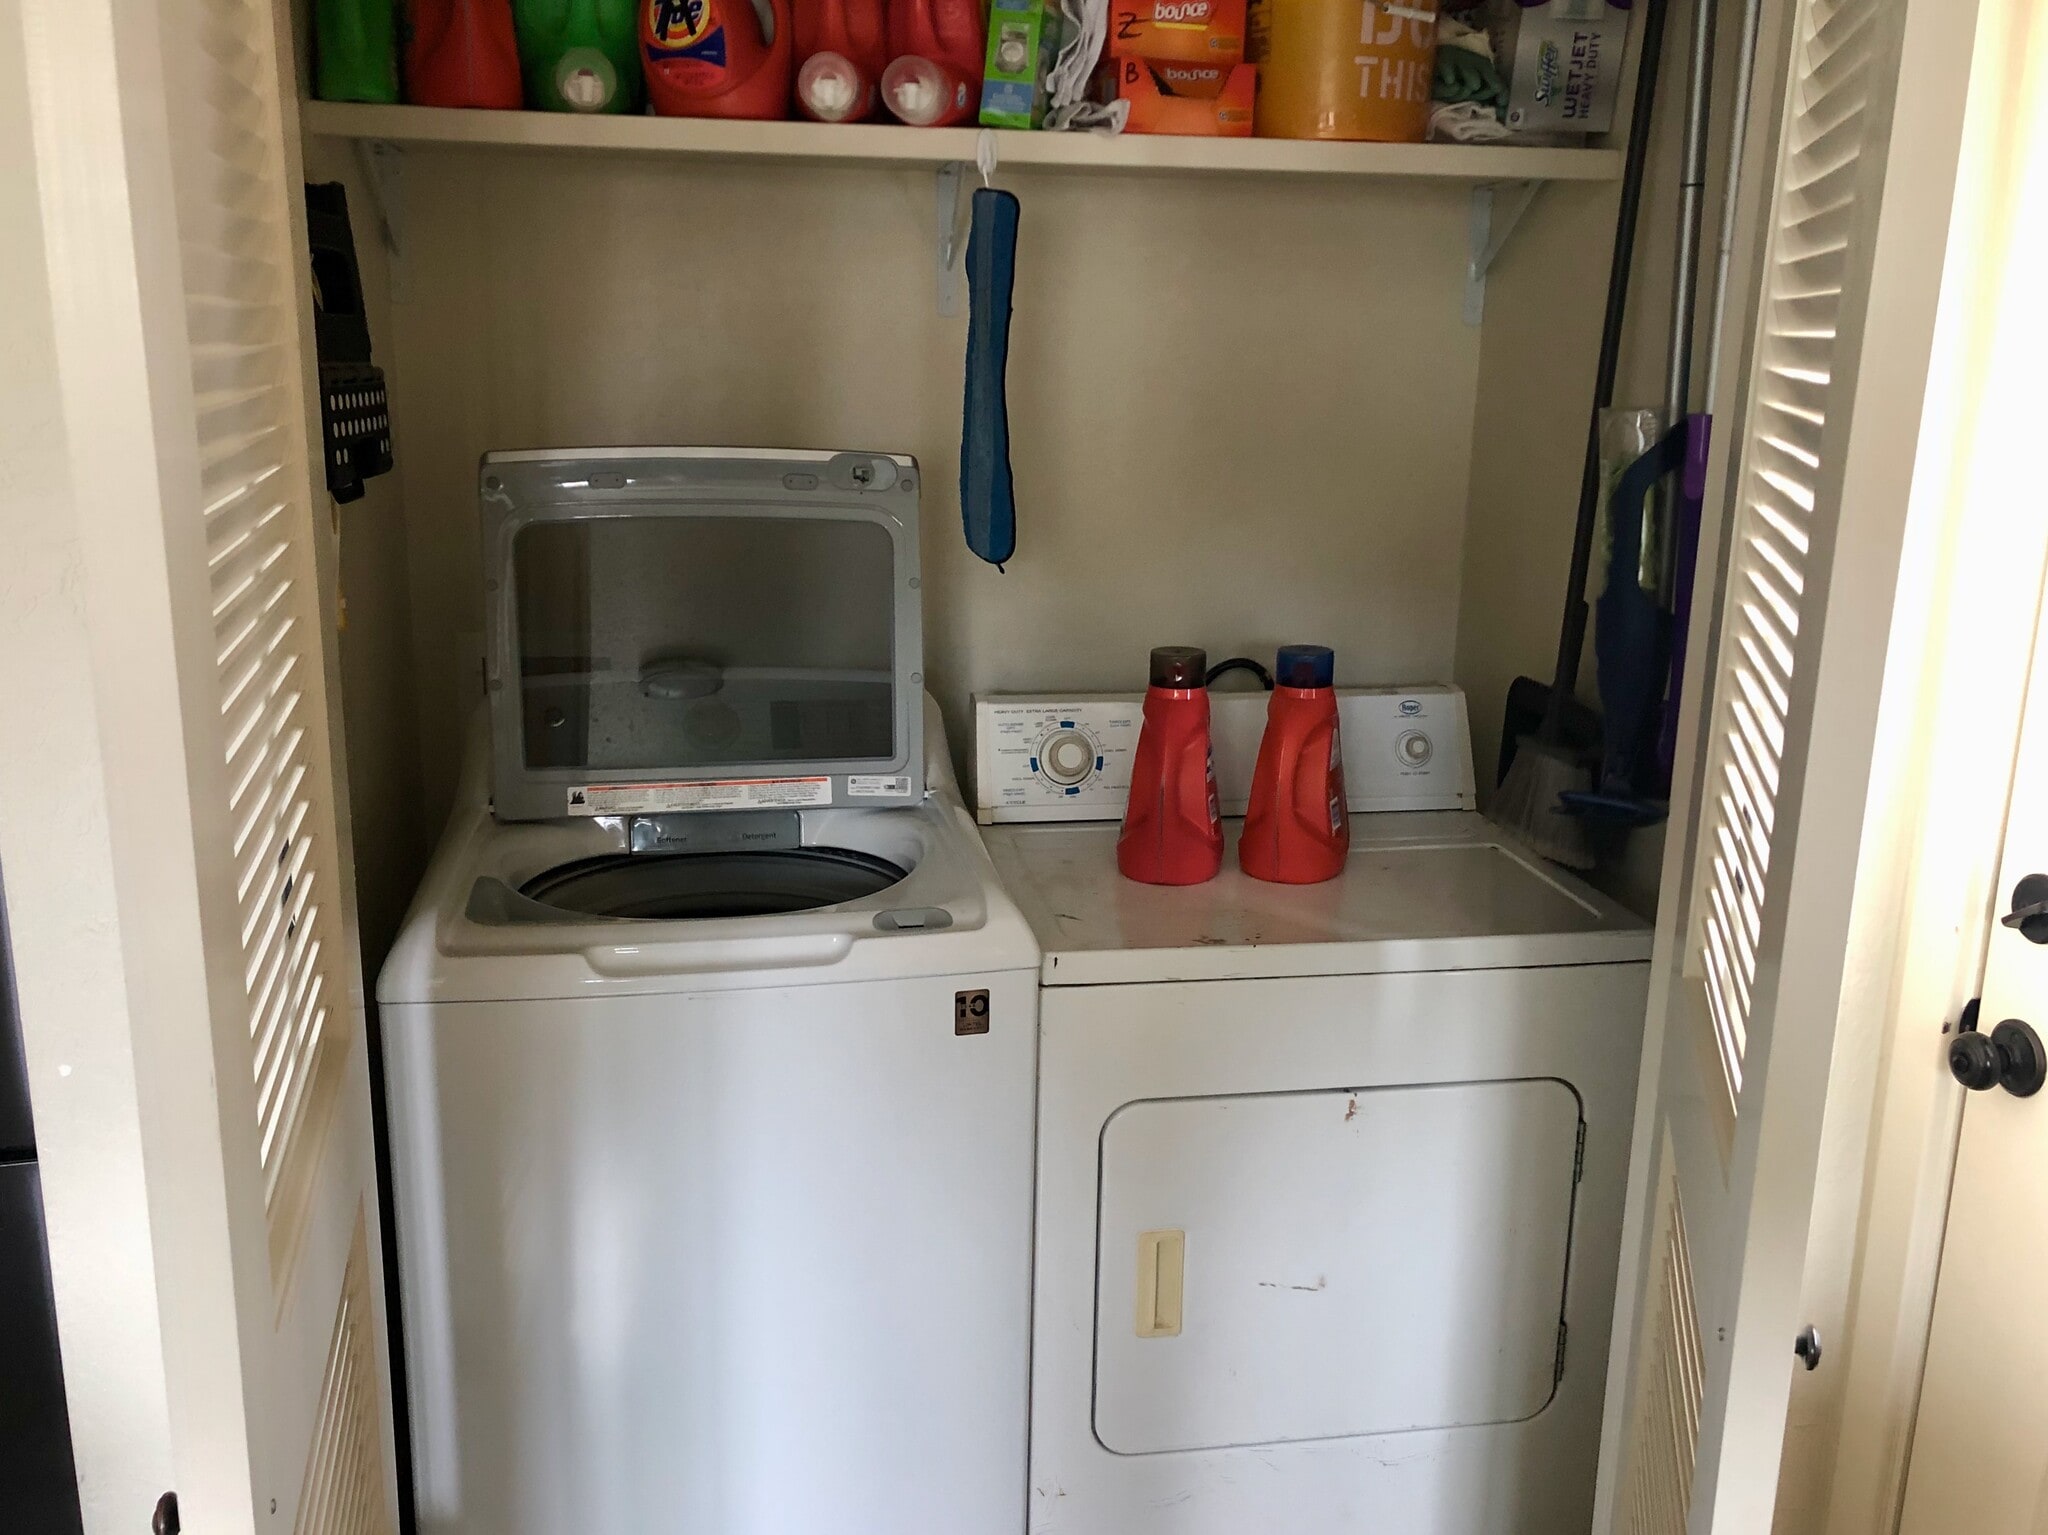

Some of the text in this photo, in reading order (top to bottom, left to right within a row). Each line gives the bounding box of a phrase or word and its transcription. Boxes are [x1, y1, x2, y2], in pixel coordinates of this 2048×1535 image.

[1154, 3, 1208, 20] bounce
[1126, 62, 1139, 84] B
[1166, 68, 1219, 81] bounce
[1354, 56, 1430, 102] THIS
[1578, 32, 1601, 119] HEAVY DUTY
[742, 832, 777, 842] Detergent
[956, 995, 989, 1018] 10
